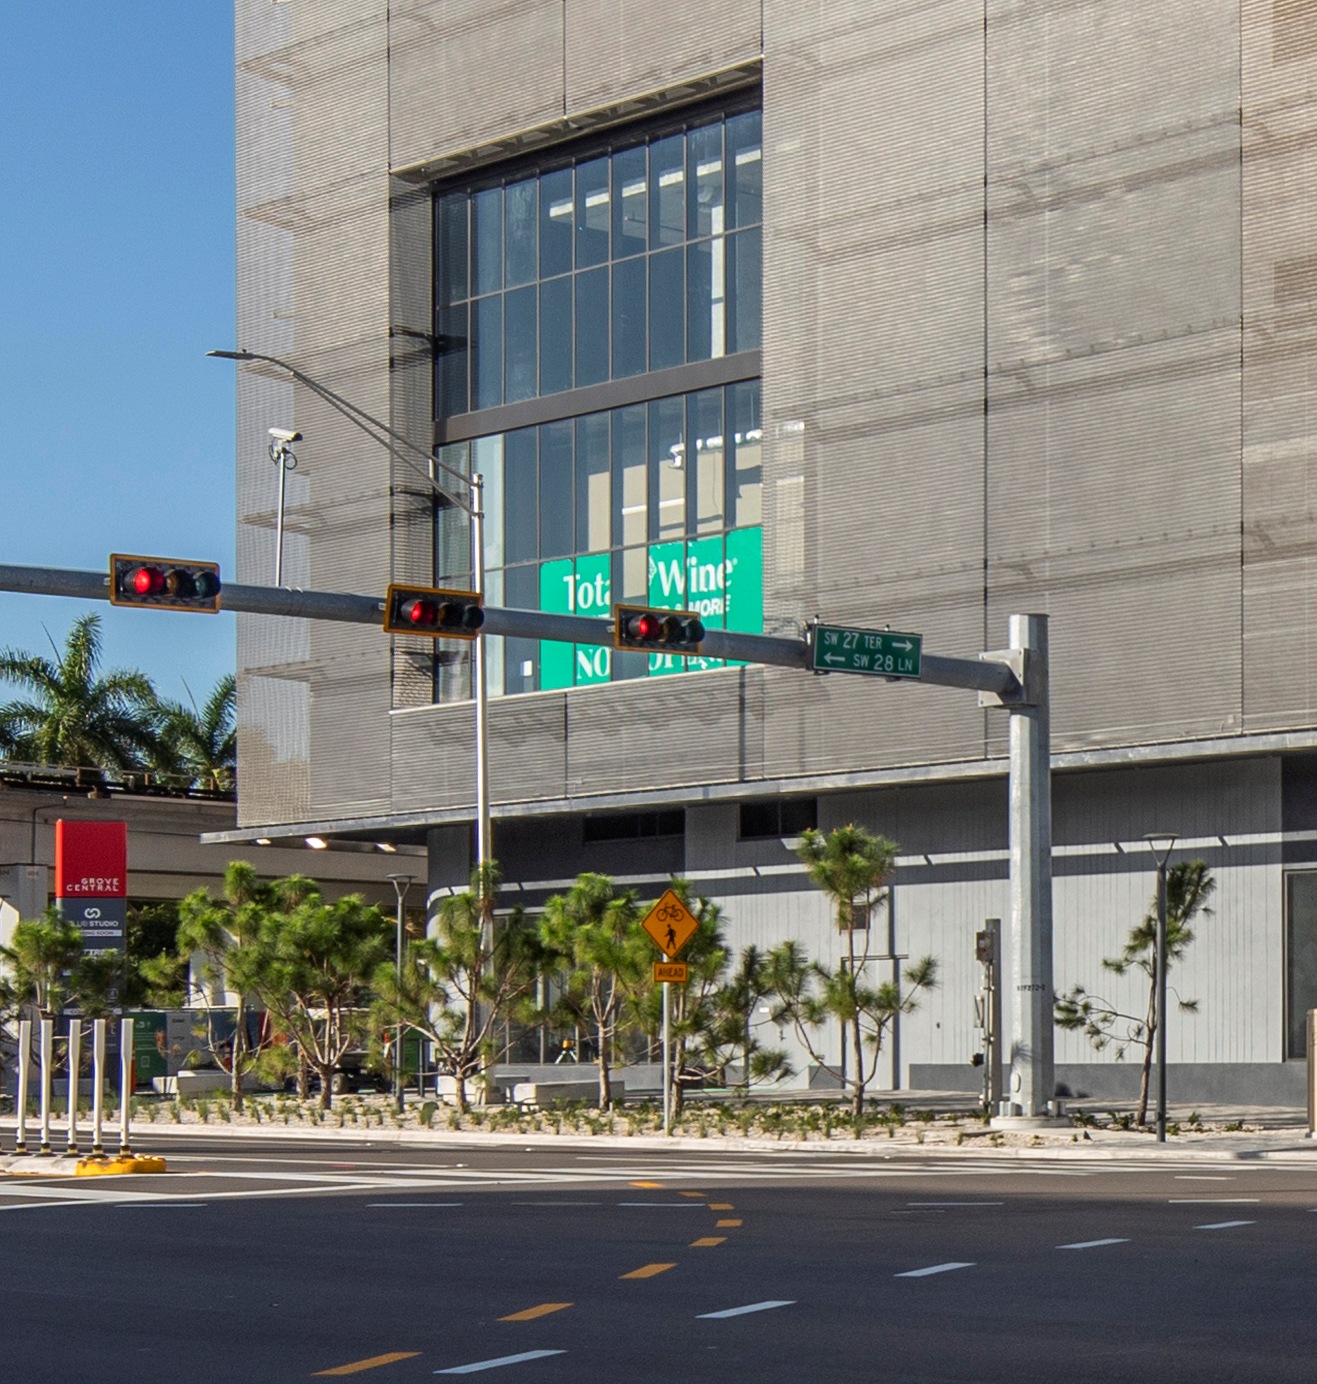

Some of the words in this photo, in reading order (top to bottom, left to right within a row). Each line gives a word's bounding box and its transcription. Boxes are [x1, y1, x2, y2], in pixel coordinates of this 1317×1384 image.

[562, 572, 611, 611] Tot
[657, 556, 734, 597] Wine
[688, 597, 732, 617] MORE
[824, 632, 839, 645] SW
[843, 632, 859, 649] 27
[864, 635, 883, 649] TER
[576, 646, 612, 679] NO
[853, 653, 870, 667] SW
[873, 654, 894, 671] 28
[898, 658, 913, 671] LN
[66, 884, 119, 892] CENTRAL
[81, 877, 119, 885] GROVE
[658, 967, 684, 978] AHEAD
